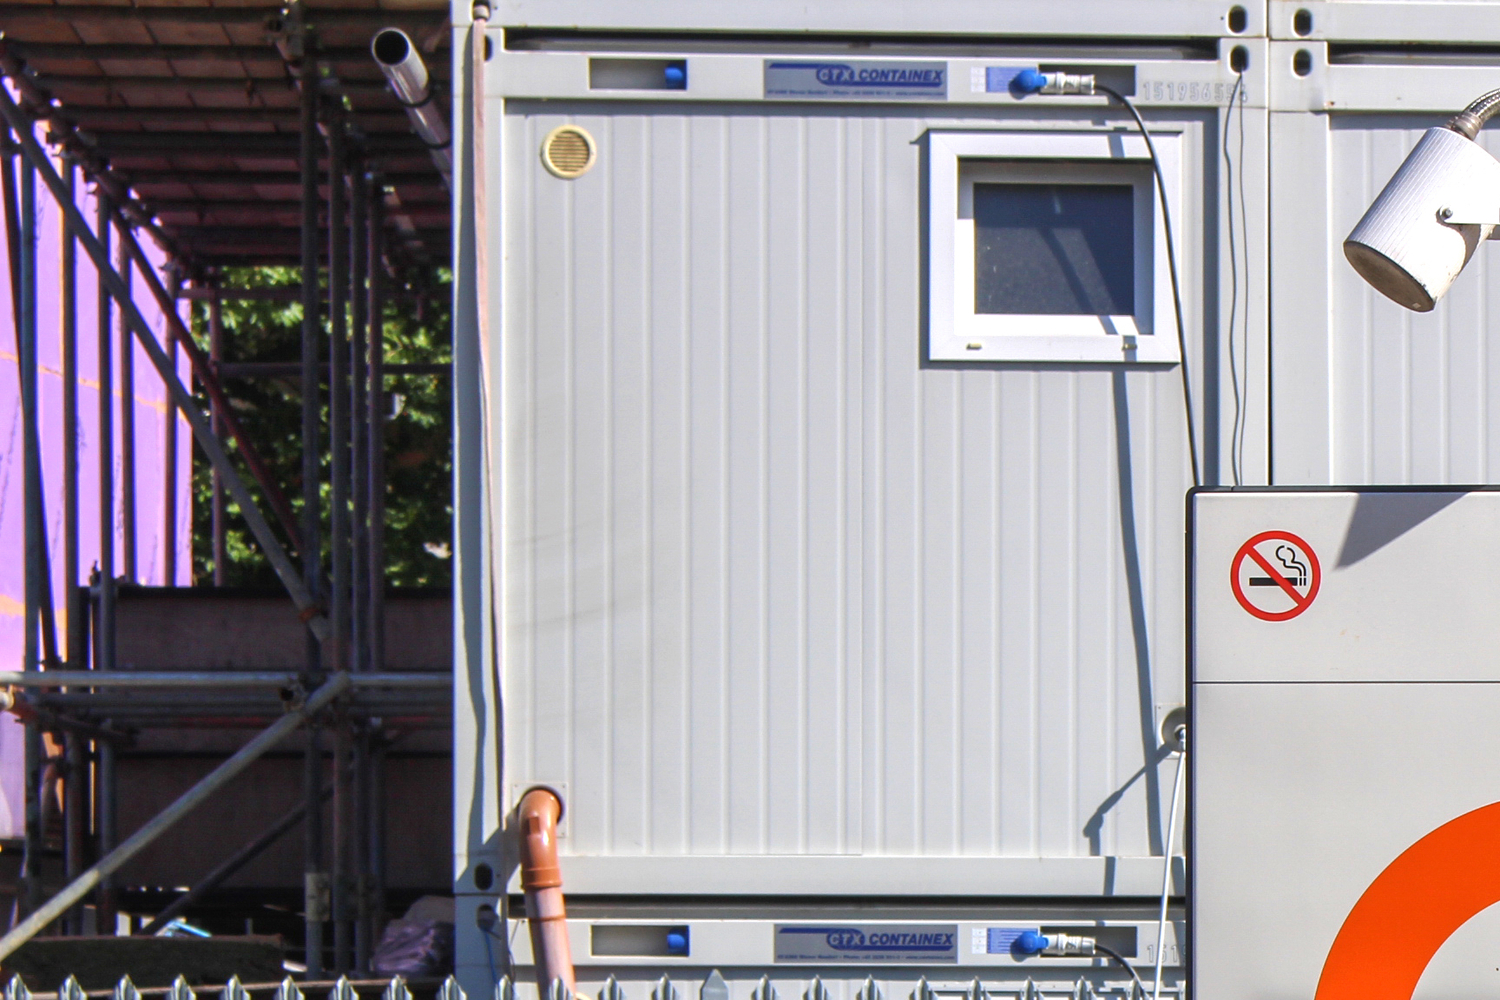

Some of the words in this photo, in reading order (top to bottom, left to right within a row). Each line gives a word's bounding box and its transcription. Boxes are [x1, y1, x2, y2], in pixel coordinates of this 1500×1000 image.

[858, 69, 944, 82] CONTAINEX
[828, 932, 865, 945] CTX
[868, 933, 954, 946] CONTAINEX
